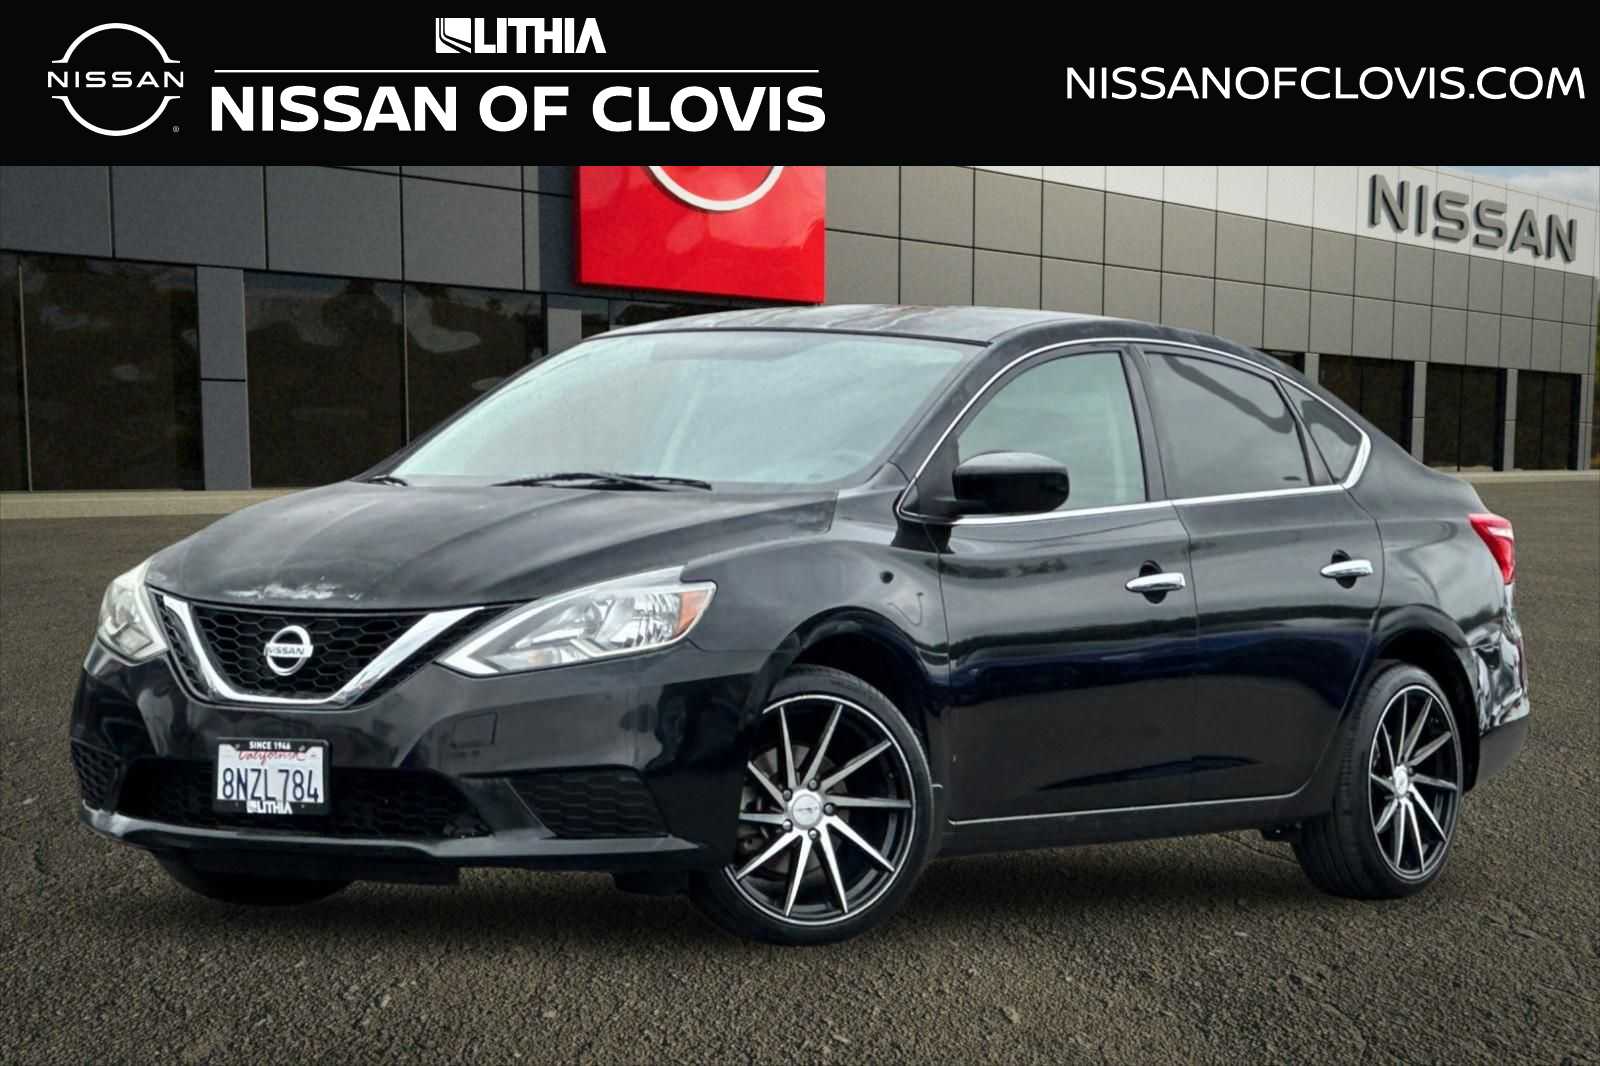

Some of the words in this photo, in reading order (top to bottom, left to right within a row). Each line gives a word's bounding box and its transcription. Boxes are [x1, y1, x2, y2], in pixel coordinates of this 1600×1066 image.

[1368, 174, 1577, 263] NISSAN
[264, 645, 305, 656] NISSAN
[249, 741, 271, 749] SINCE
[274, 742, 291, 750] 1946
[257, 801, 293, 814] LITHIA
